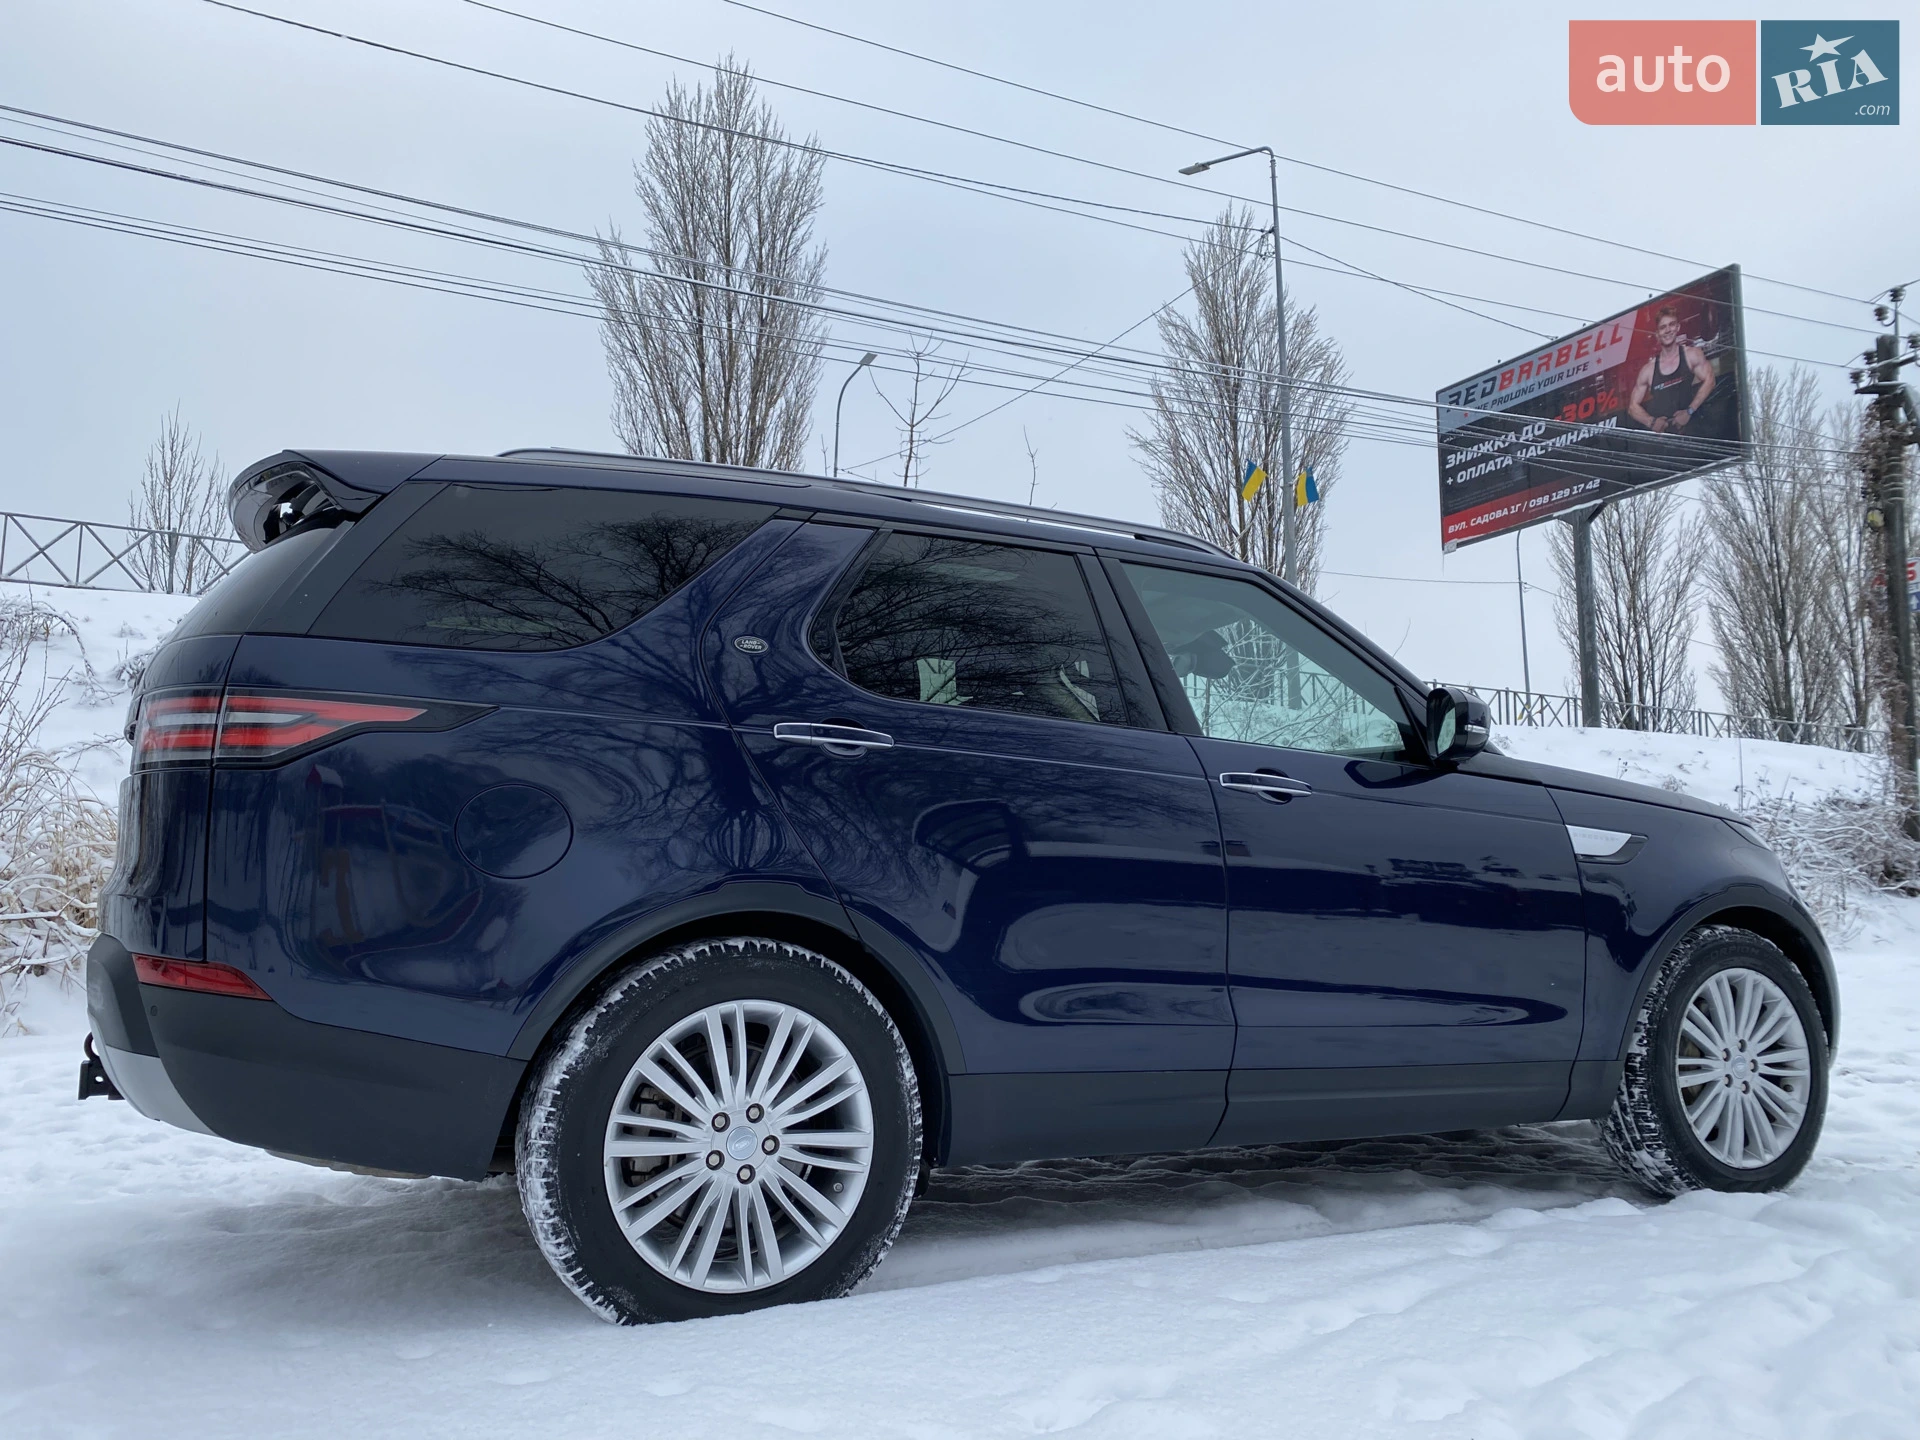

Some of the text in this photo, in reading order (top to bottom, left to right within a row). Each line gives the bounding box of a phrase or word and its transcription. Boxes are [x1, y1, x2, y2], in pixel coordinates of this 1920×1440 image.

[1490, 383, 1536, 410] PROLONG
[1537, 371, 1564, 391] YOUR
[1566, 361, 1590, 379] LIFE
[1445, 431, 1517, 469] ЗНИЖКА
[1519, 421, 1547, 442] ДО
[1456, 453, 1513, 484] ОПЛАТА
[1516, 415, 1618, 461] ЧАСТИНАМИ
[1448, 522, 1468, 534] ВУЛ.
[1470, 508, 1509, 526] САДОВА
[1529, 494, 1550, 508] 098
[1550, 488, 1571, 502] 129
[1572, 483, 1585, 495] 17
[1585, 478, 1601, 490] 42
